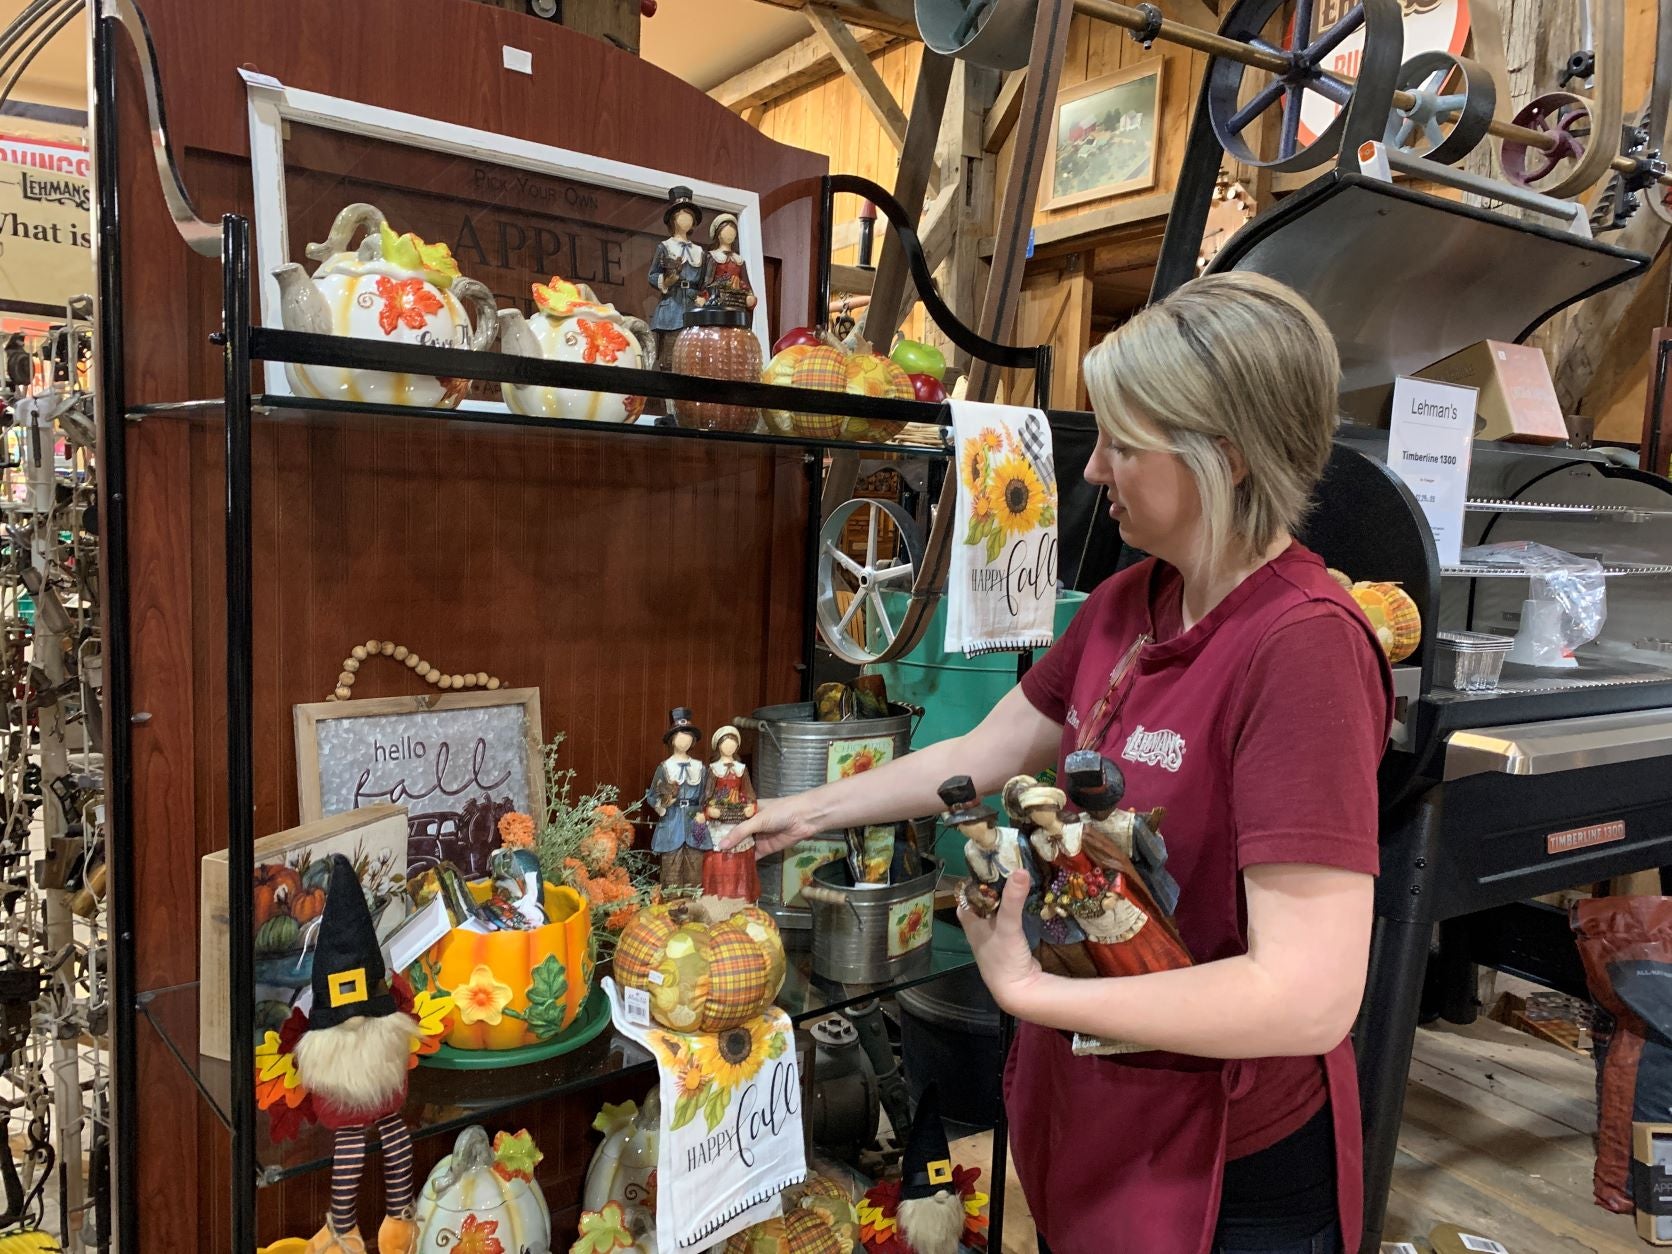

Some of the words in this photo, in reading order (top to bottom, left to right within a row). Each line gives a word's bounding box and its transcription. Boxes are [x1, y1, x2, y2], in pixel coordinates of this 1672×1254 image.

[454, 214, 625, 286] APPLE
[1411, 398, 1457, 420] Lehman's
[1402, 450, 1439, 464] Timberline
[1440, 454, 1457, 465] 1300
[971, 567, 1006, 592] HAPPY
[1004, 532, 1058, 617] fall
[353, 737, 512, 809] fall
[374, 736, 427, 762] hello
[1550, 828, 1602, 850] TIMBERLINE
[1603, 823, 1624, 838] 1300
[687, 1127, 738, 1173] HAPPY
[733, 1061, 798, 1168] fall
